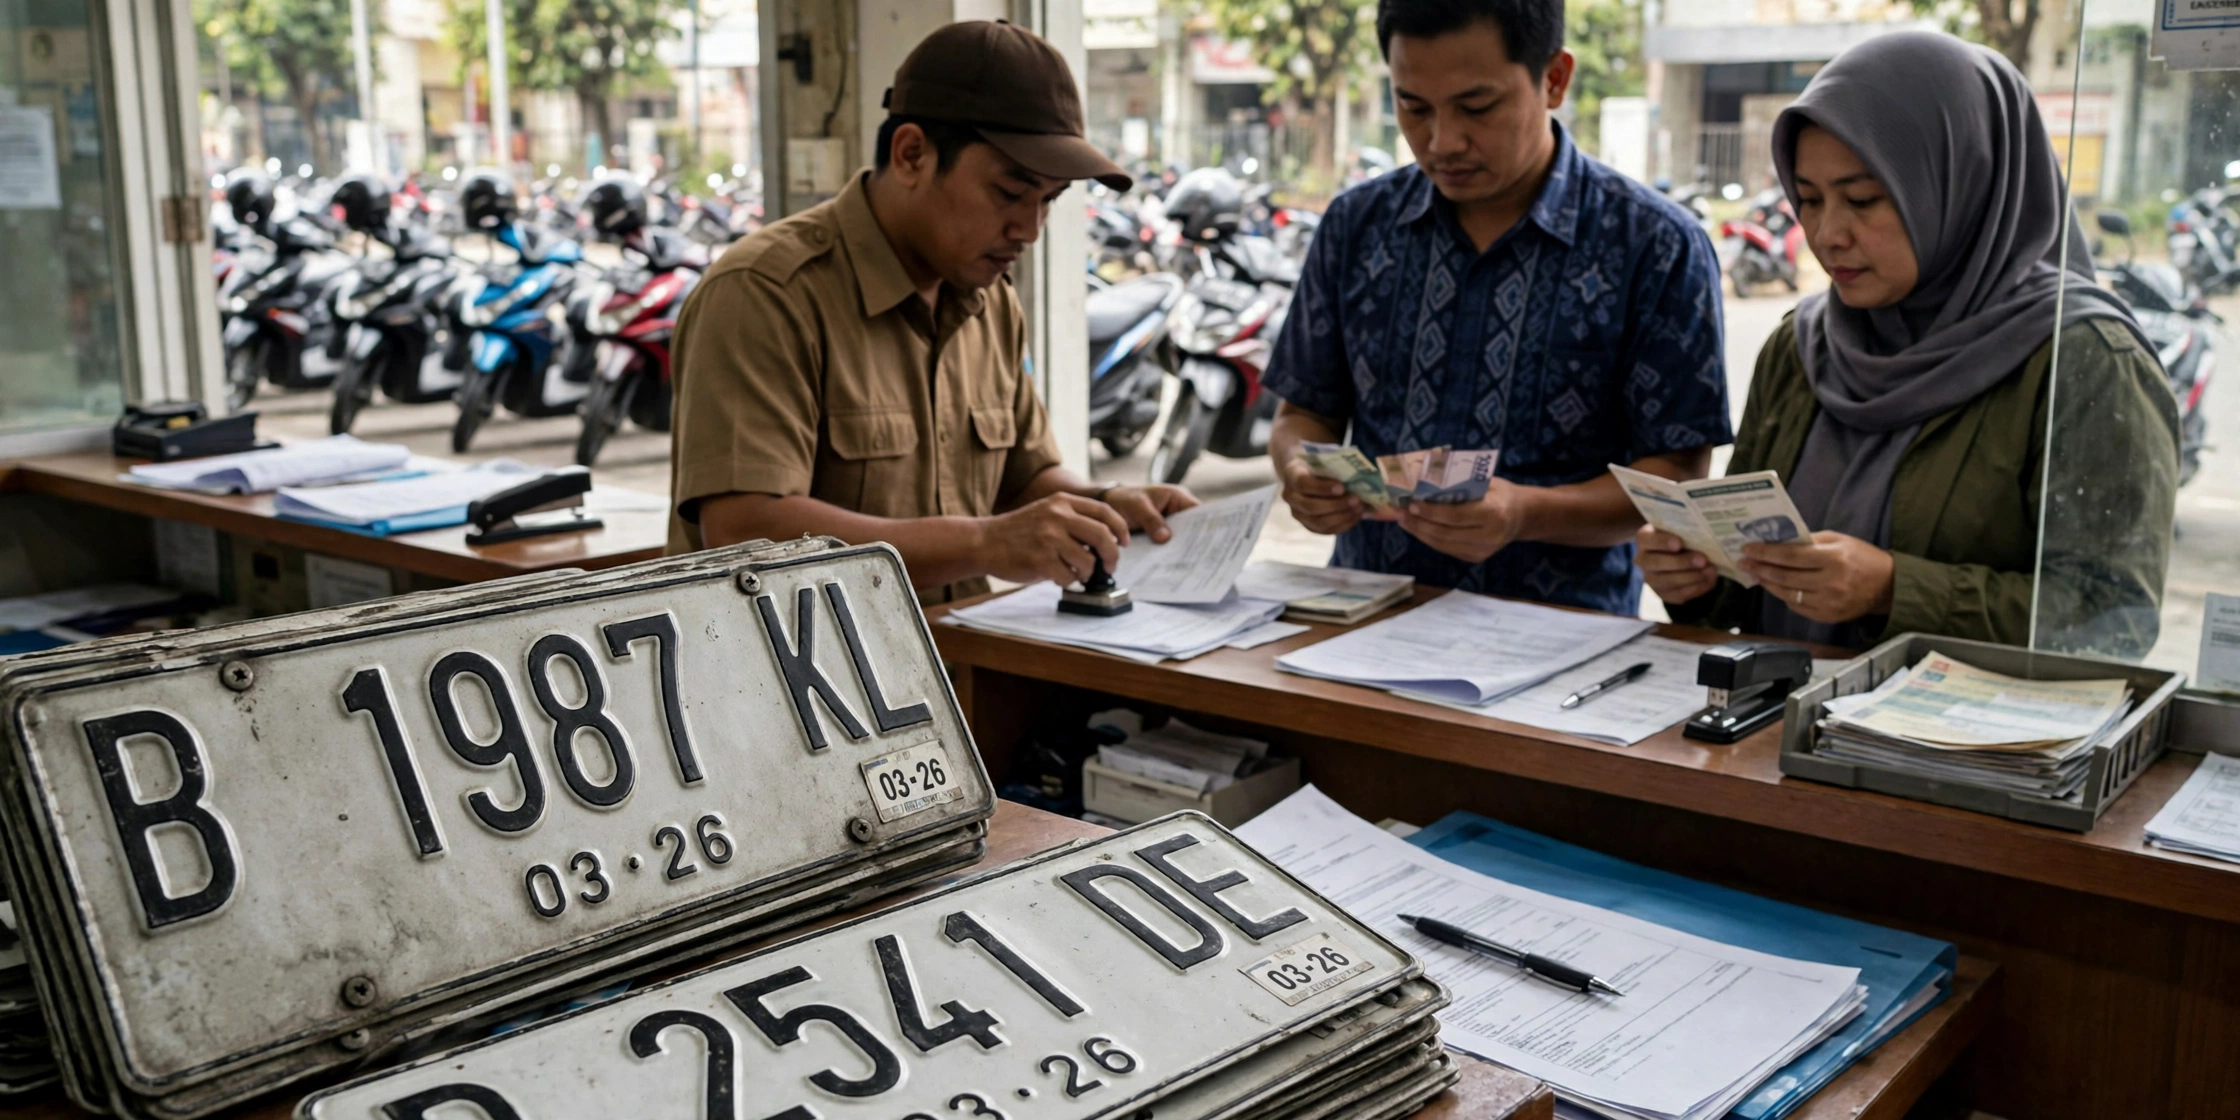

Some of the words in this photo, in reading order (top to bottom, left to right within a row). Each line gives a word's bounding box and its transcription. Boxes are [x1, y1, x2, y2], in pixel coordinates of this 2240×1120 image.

[83, 710, 237, 929] B
[344, 612, 704, 856] 1987
[755, 582, 934, 750] KL
[630, 911, 1084, 1120] 2541
[1060, 833, 1310, 970] DE
